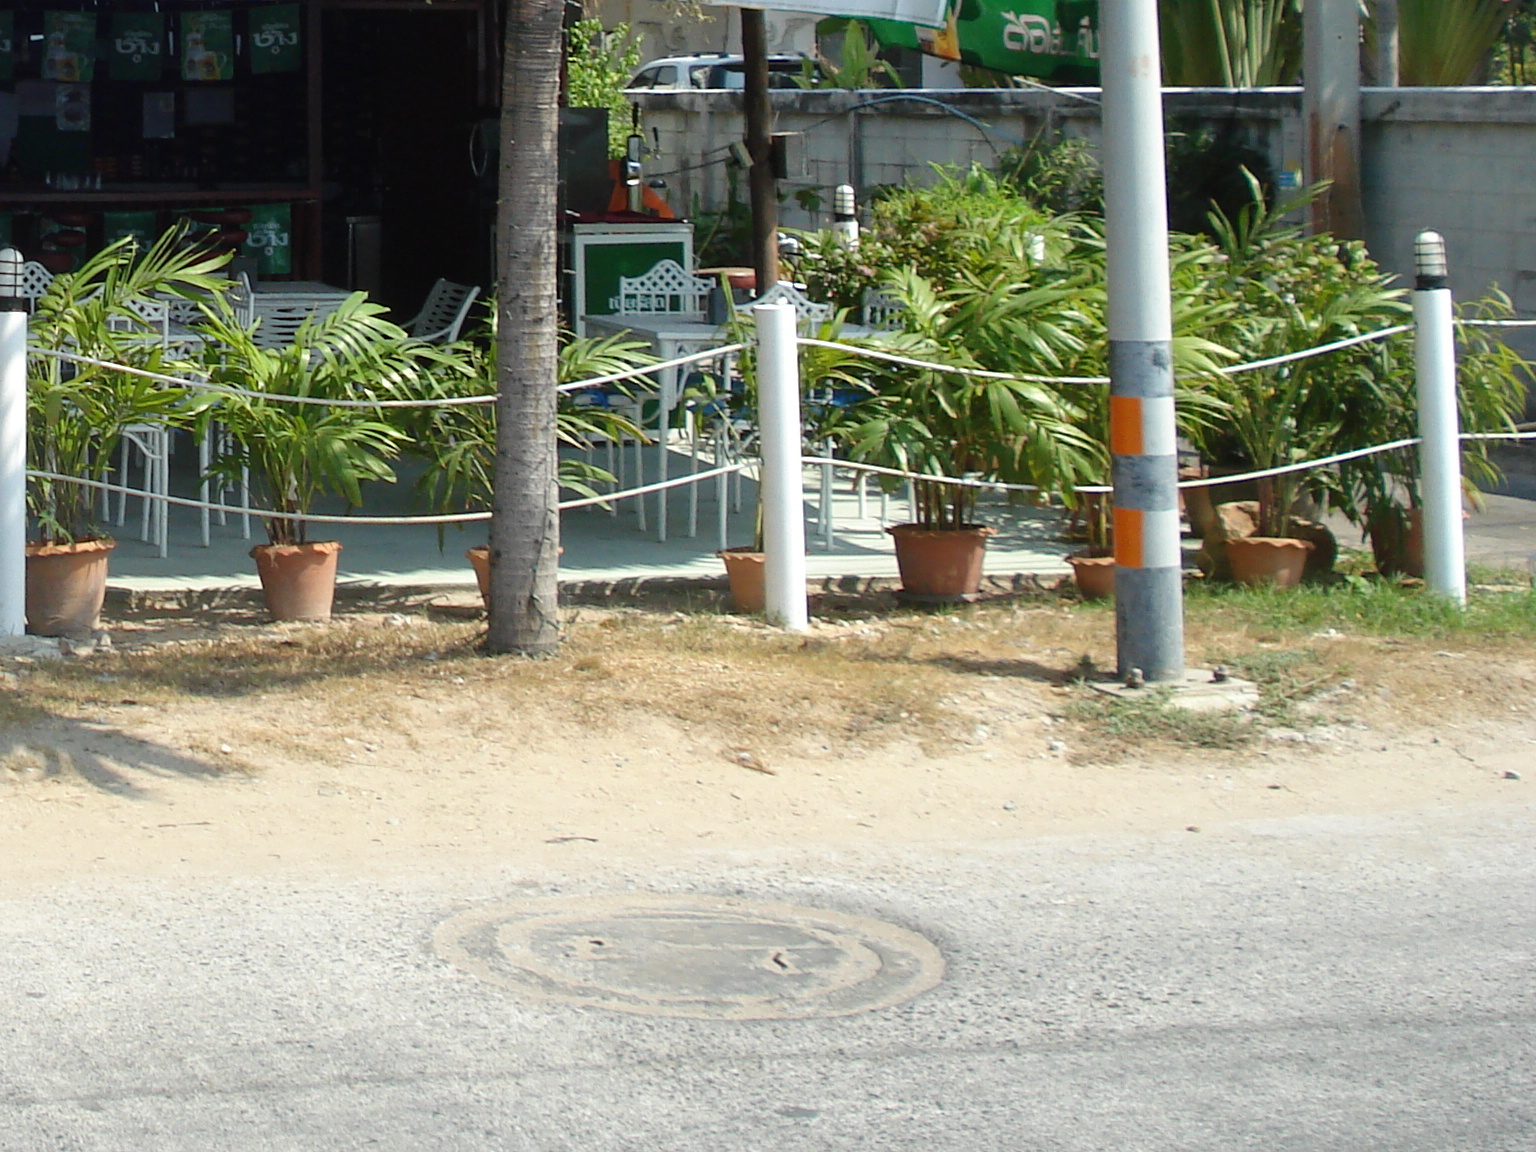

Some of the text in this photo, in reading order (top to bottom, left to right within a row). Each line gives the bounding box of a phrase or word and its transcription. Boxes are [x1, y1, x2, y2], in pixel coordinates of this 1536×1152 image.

[114, 35, 160, 55] ช้าง
[252, 28, 298, 48] ช้าง
[246, 228, 290, 248] ช้าง
